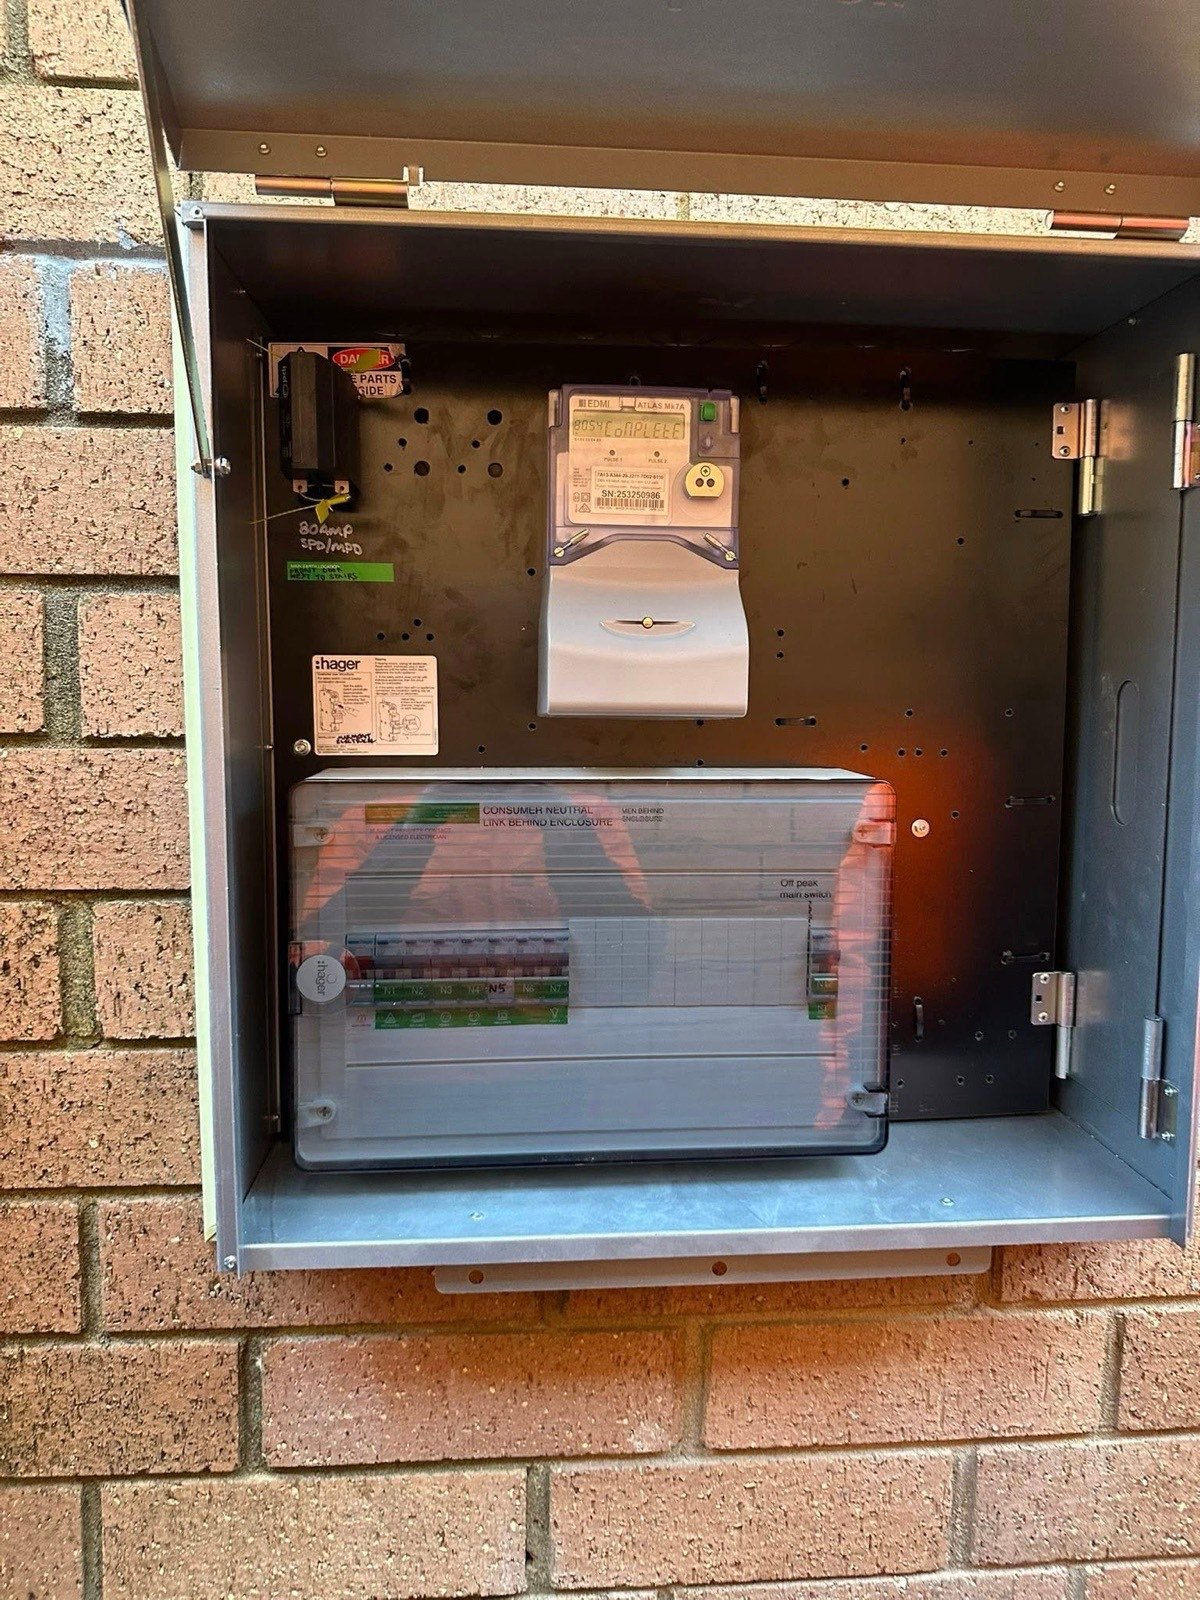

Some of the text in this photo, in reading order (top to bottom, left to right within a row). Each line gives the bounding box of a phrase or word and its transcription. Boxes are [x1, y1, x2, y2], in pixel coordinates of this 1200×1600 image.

[340, 354, 389, 365] DAR
[360, 374, 397, 384] PARTS
[358, 386, 384, 395] SIDE
[587, 399, 610, 408] EDMI
[601, 489, 661, 500] SN:253250986
[483, 806, 593, 815] CONSUMER NEUTRAL
[483, 818, 613, 827] LINK BEHIND ENCLOSURE
[622, 815, 663, 823] ENCLOSURE
[780, 879, 819, 889] Off peak
[383, 986, 395, 995] N1
[411, 986, 424, 995] N2
[440, 986, 453, 994] N3
[468, 986, 480, 994] N4
[488, 983, 506, 993] N5
